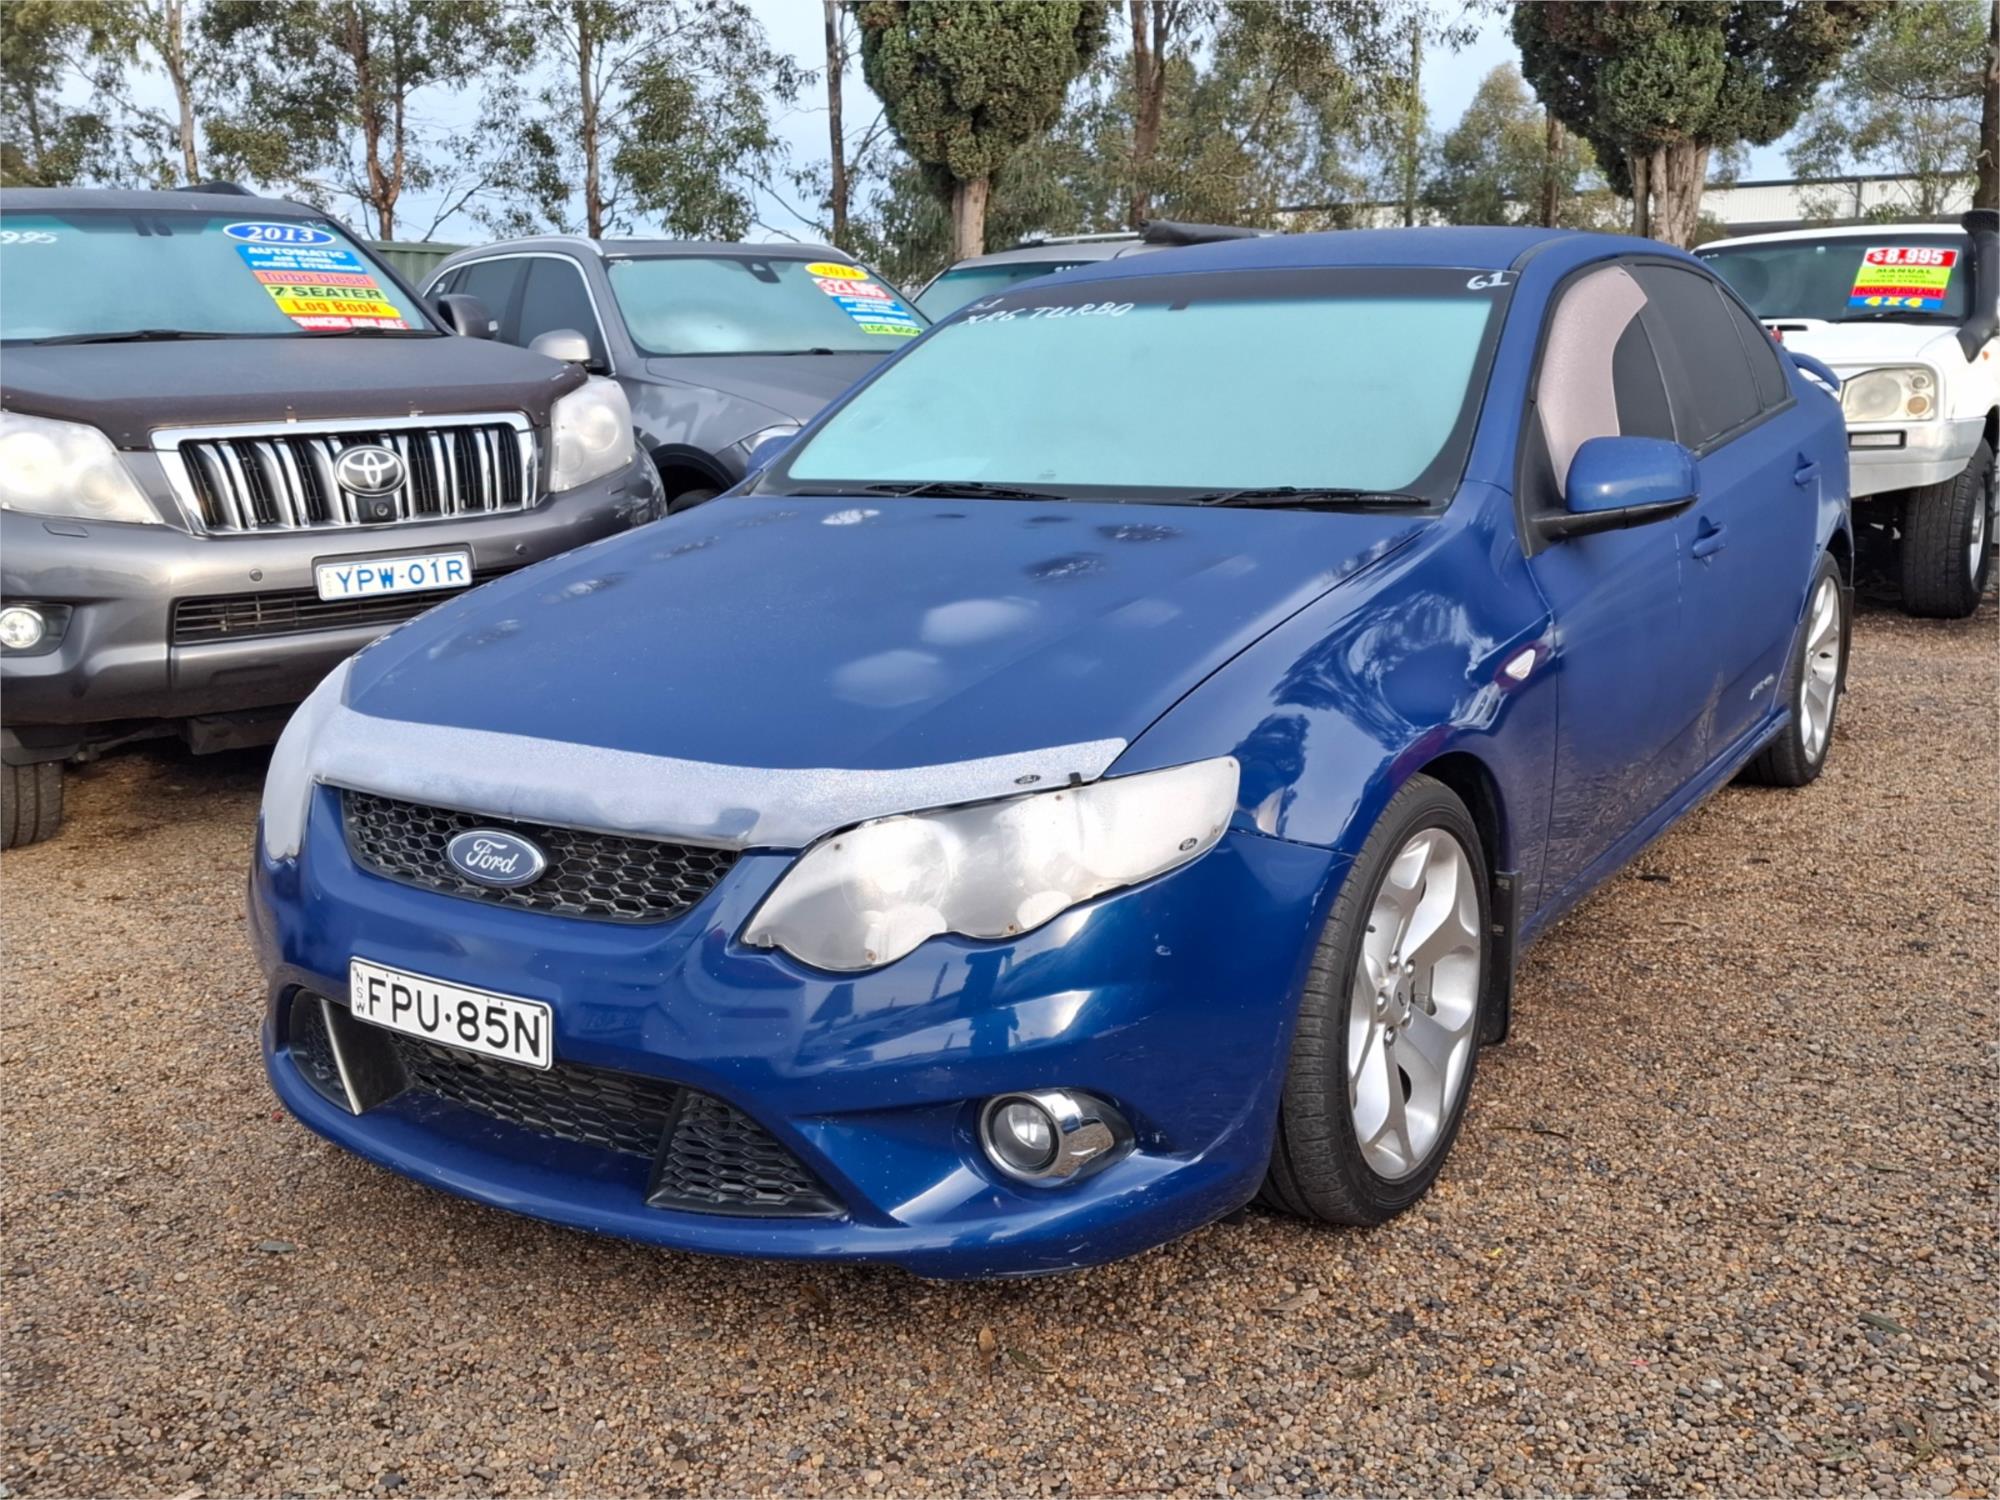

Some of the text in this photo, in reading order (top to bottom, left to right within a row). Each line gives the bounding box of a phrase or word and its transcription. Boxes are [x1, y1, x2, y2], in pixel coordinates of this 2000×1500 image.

[247, 226, 314, 242] 2013
[247, 246, 348, 259] AUTOMATIC
[1872, 248, 1944, 265] $8,995
[251, 261, 300, 269] POWER
[1875, 267, 1932, 275] MANUAL
[263, 271, 370, 285] Turbo Diesel
[269, 286, 384, 299] 7 SEATER
[292, 300, 382, 313] Log Book
[1029, 301, 1135, 320] TURBO
[465, 838, 520, 874] Ford
